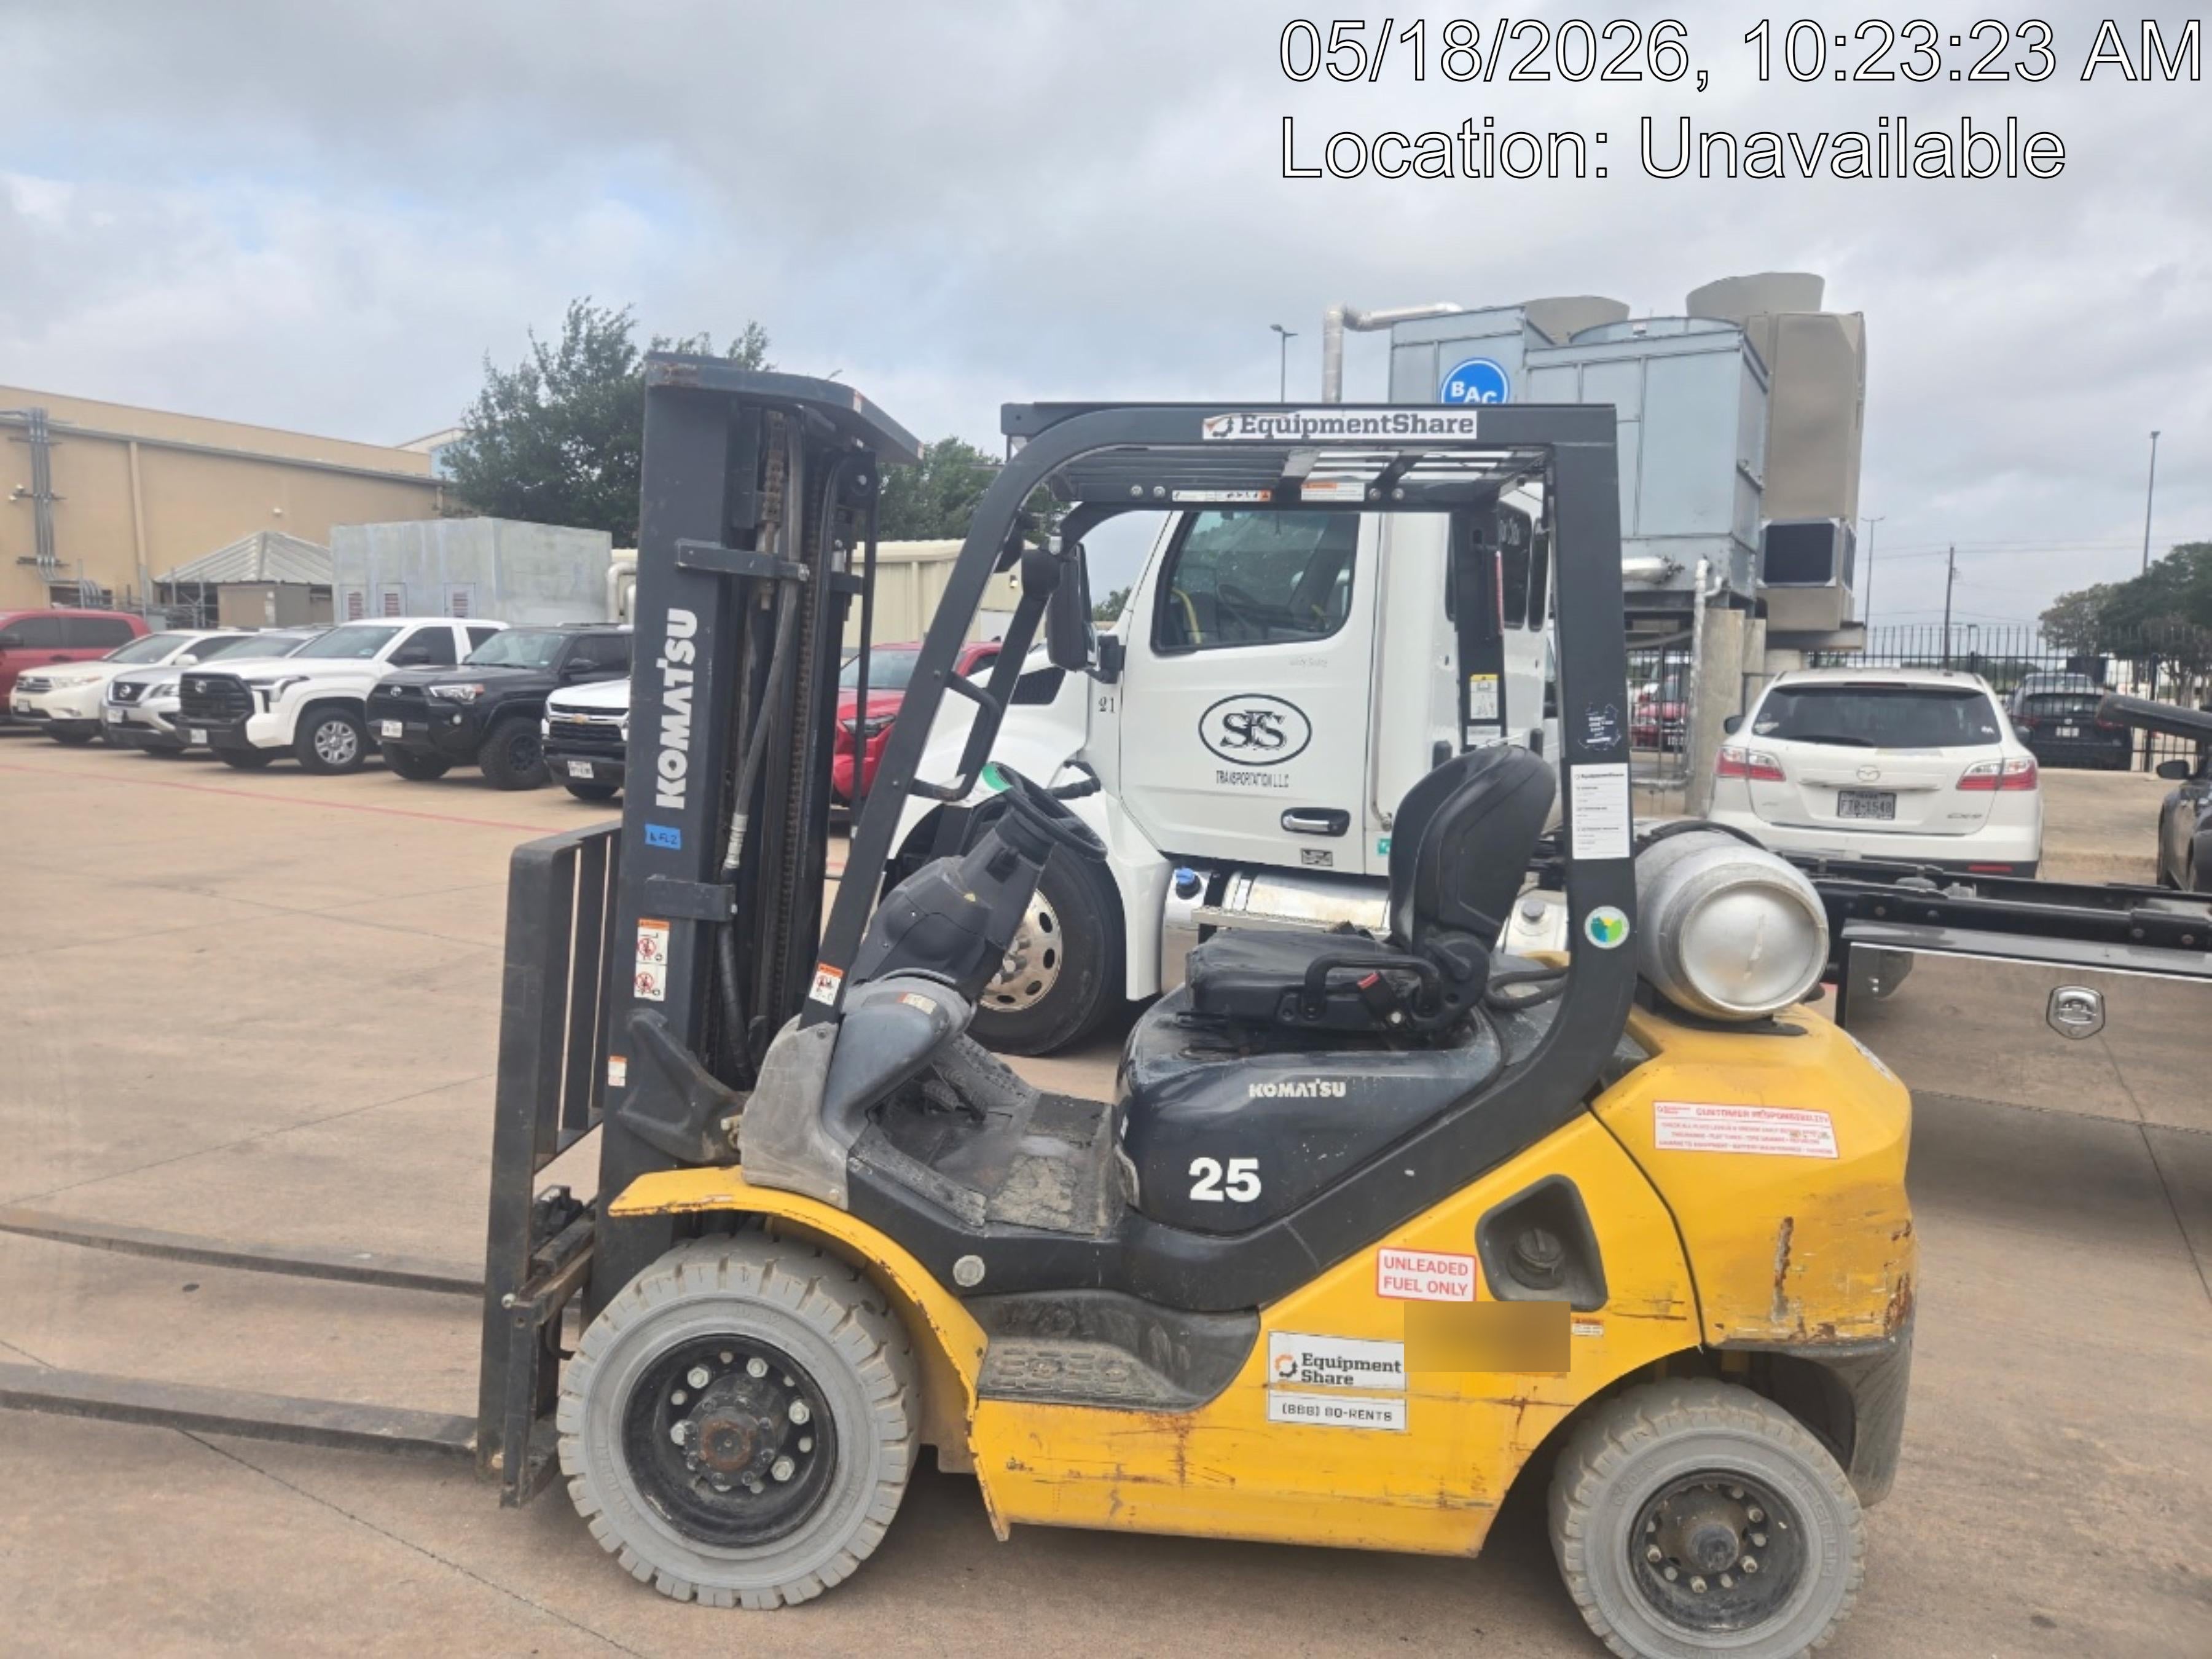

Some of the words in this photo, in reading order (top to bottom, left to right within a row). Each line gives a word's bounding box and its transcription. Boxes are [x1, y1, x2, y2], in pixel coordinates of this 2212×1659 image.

[1239, 413, 1474, 439] EquipmentShare
[655, 607, 698, 809] KOMATSU
[1098, 696, 1115, 713] 21
[1248, 1078, 1347, 1098] KOMATSU
[1188, 1156, 1262, 1203] 25
[1383, 1255, 1469, 1276] UNLEADED
[1383, 1275, 1423, 1293] FUEL
[1427, 1280, 1468, 1296] ONLY
[1301, 1352, 1402, 1373] Equipment
[1301, 1369, 1354, 1385] Share
[1282, 1402, 1320, 1417] (888)
[1325, 1406, 1392, 1422] 80-RENTS
